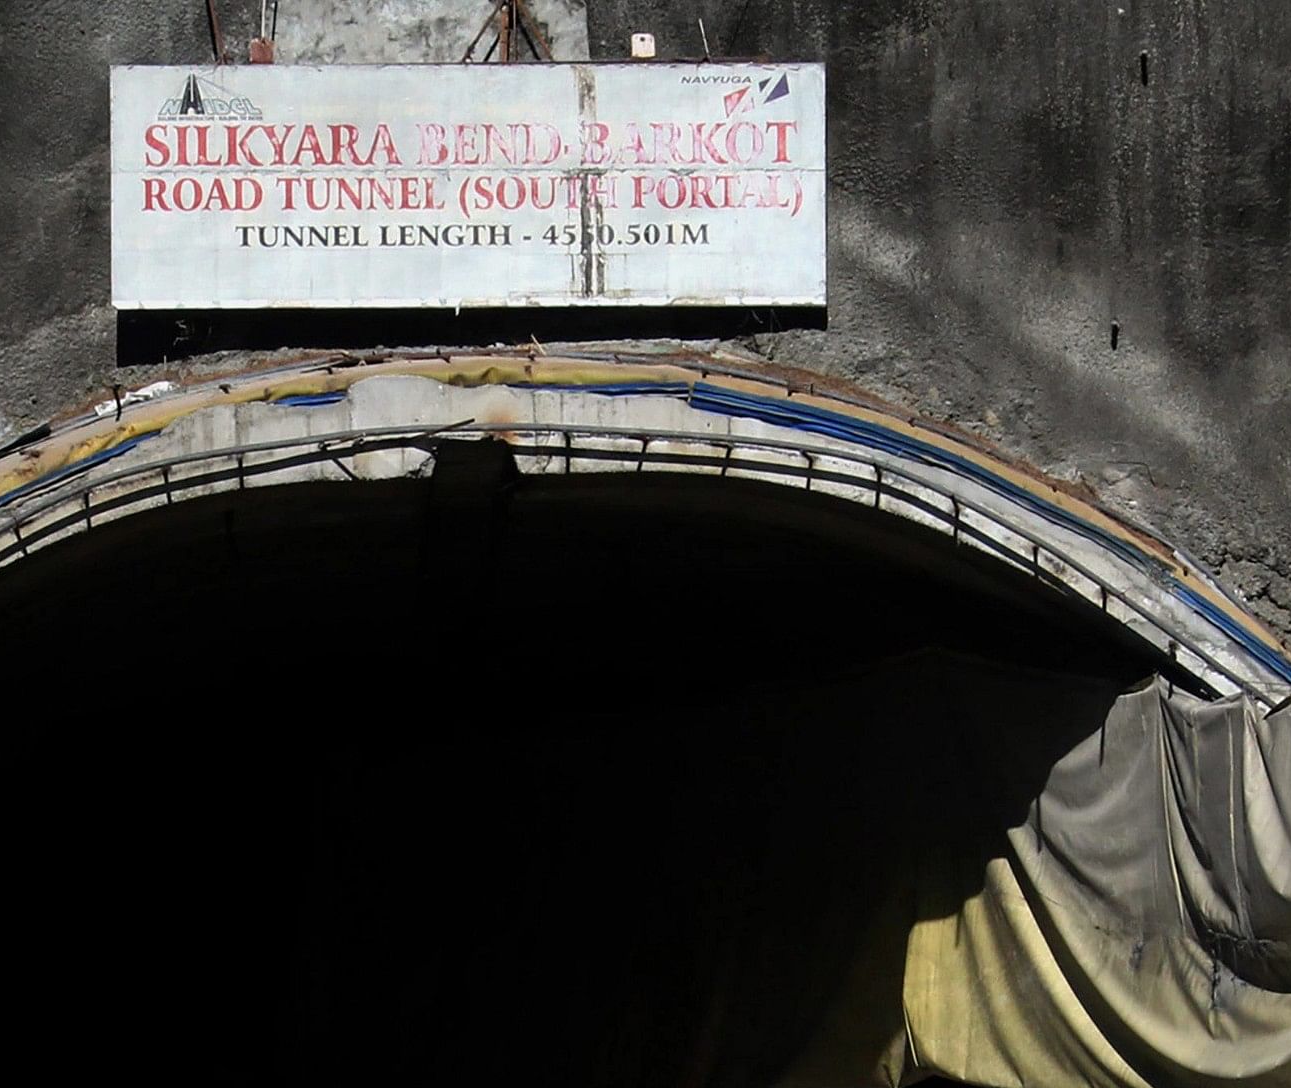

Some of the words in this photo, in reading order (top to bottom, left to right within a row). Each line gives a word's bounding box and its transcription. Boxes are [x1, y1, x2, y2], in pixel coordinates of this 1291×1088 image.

[681, 76, 753, 84] NAVYUGA
[144, 123, 402, 167] SILKYARA
[142, 176, 264, 213] ROAD
[276, 176, 445, 212] TUNNEL
[459, 174, 618, 218] (SOUTH
[631, 174, 803, 217] PORTAL)
[236, 224, 368, 247] TUNNEL
[380, 224, 513, 247] LENGTH
